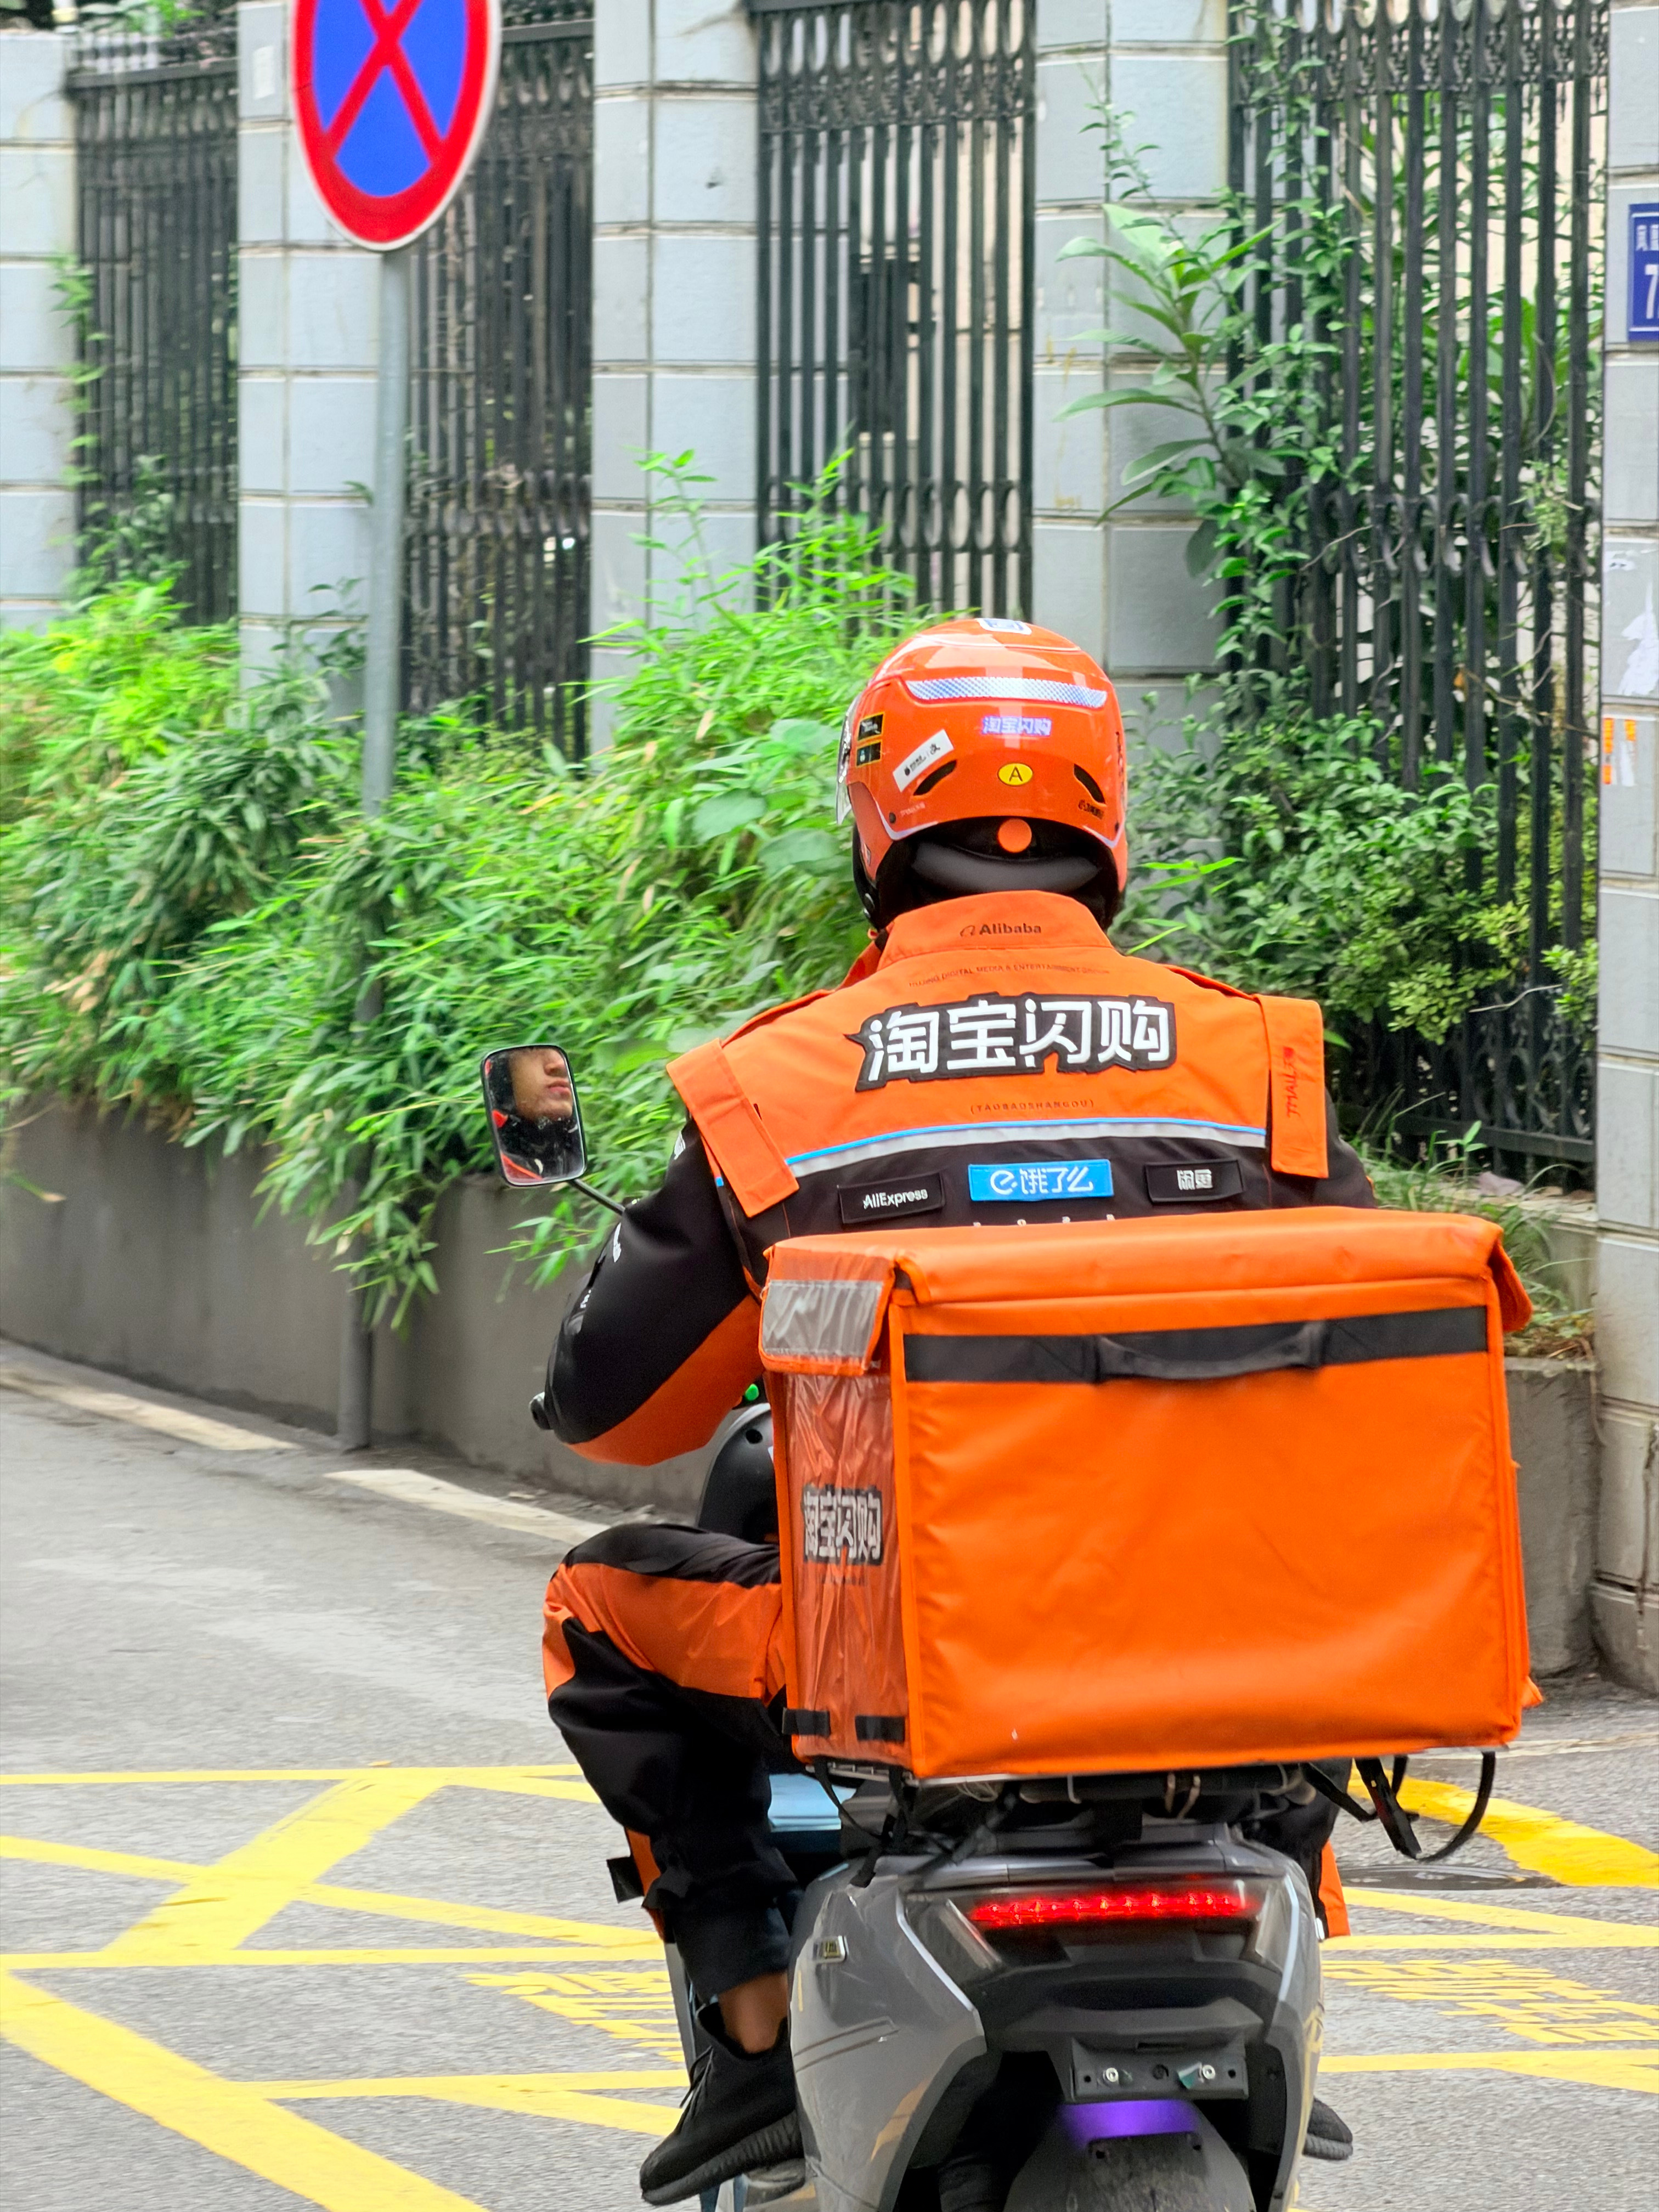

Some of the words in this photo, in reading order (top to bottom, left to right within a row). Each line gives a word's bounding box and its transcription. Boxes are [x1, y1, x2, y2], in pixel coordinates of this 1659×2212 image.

[1645, 264, 1659, 319] 7
[982, 716, 1052, 736] 淘宝闪购
[1009, 766, 1023, 782] A
[979, 923, 1041, 935] Alibaba
[868, 998, 1169, 1082] 淘宝闪购
[1019, 1166, 1093, 1194] 饿了么
[458, 1971, 685, 2062] 禁止
